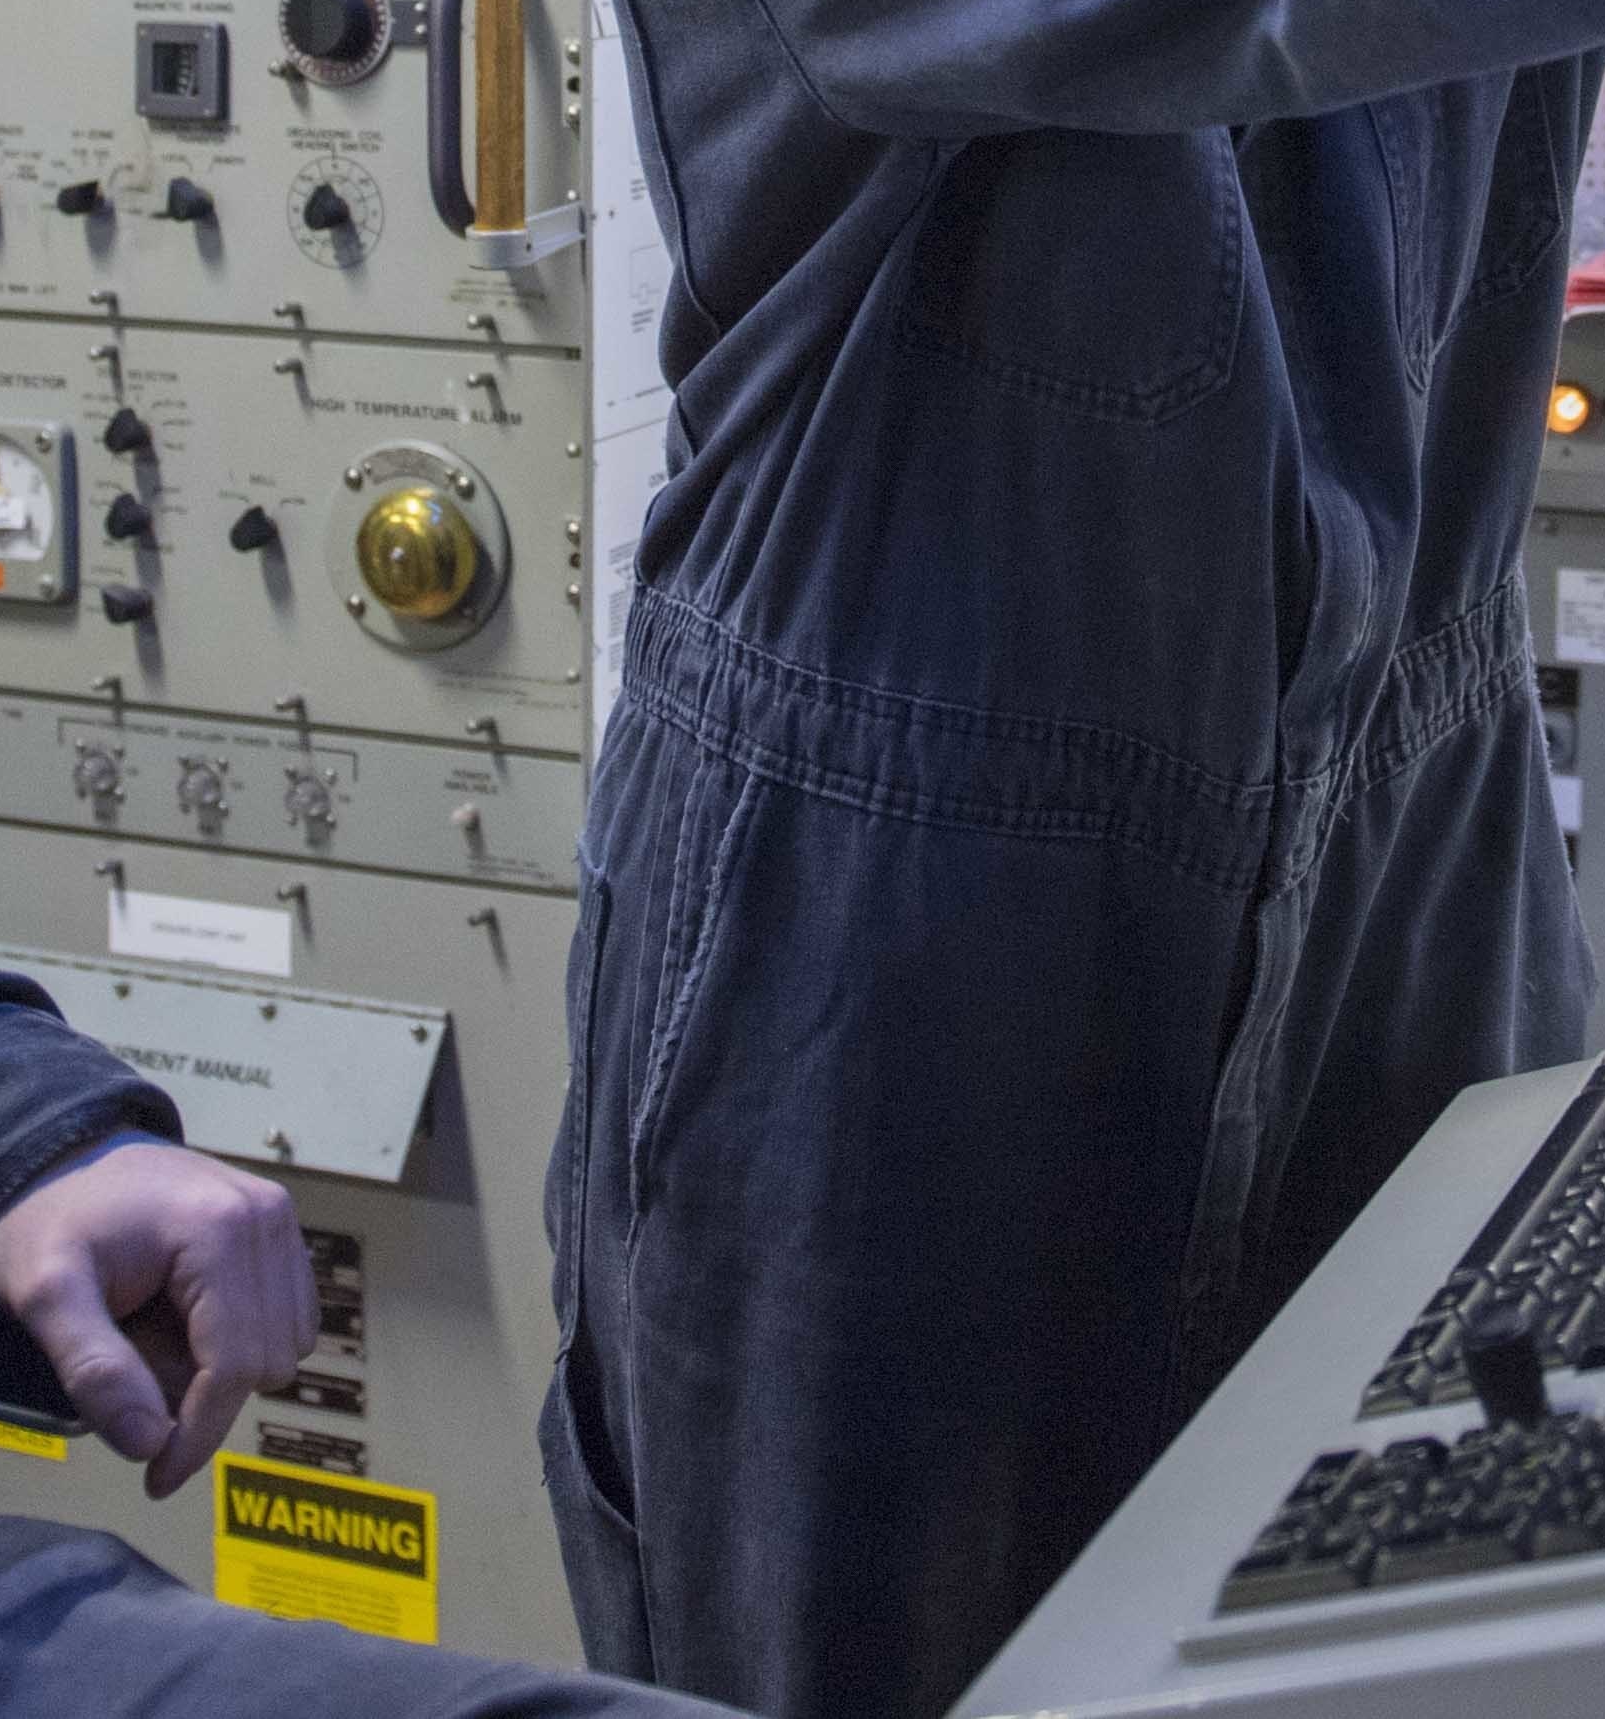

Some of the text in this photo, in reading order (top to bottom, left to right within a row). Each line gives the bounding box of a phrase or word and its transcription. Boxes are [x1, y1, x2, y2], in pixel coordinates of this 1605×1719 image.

[311, 398, 523, 427] HIGH TEMPERATURE ALARM
[114, 1044, 273, 1090] PMENT MANUAL
[230, 1486, 423, 1561] WARNING
